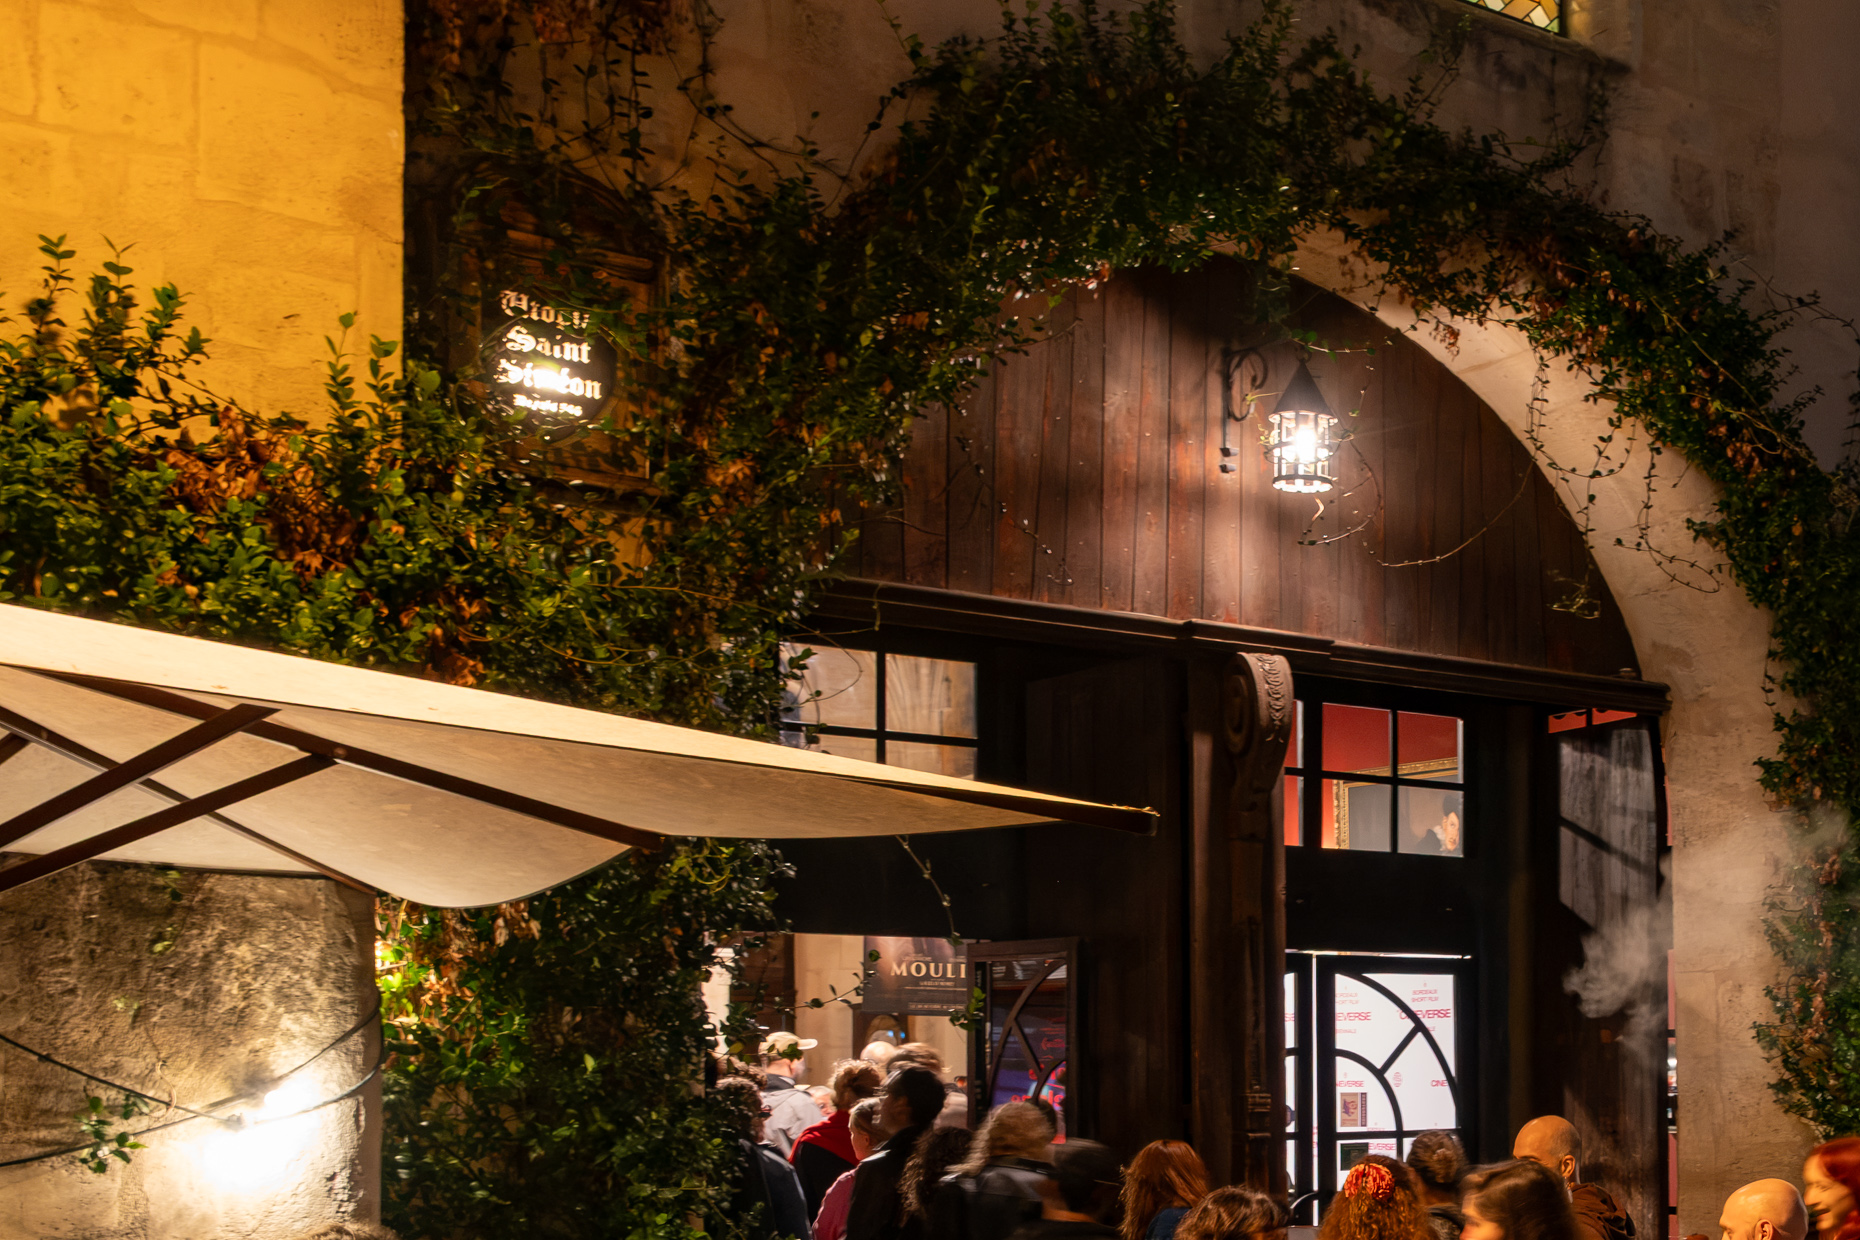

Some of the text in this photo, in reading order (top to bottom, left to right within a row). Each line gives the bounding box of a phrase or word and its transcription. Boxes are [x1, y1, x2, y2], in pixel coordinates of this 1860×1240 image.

[501, 325, 592, 365] Saint
[493, 358, 603, 400] Siéon
[890, 961, 967, 979] MOULI
